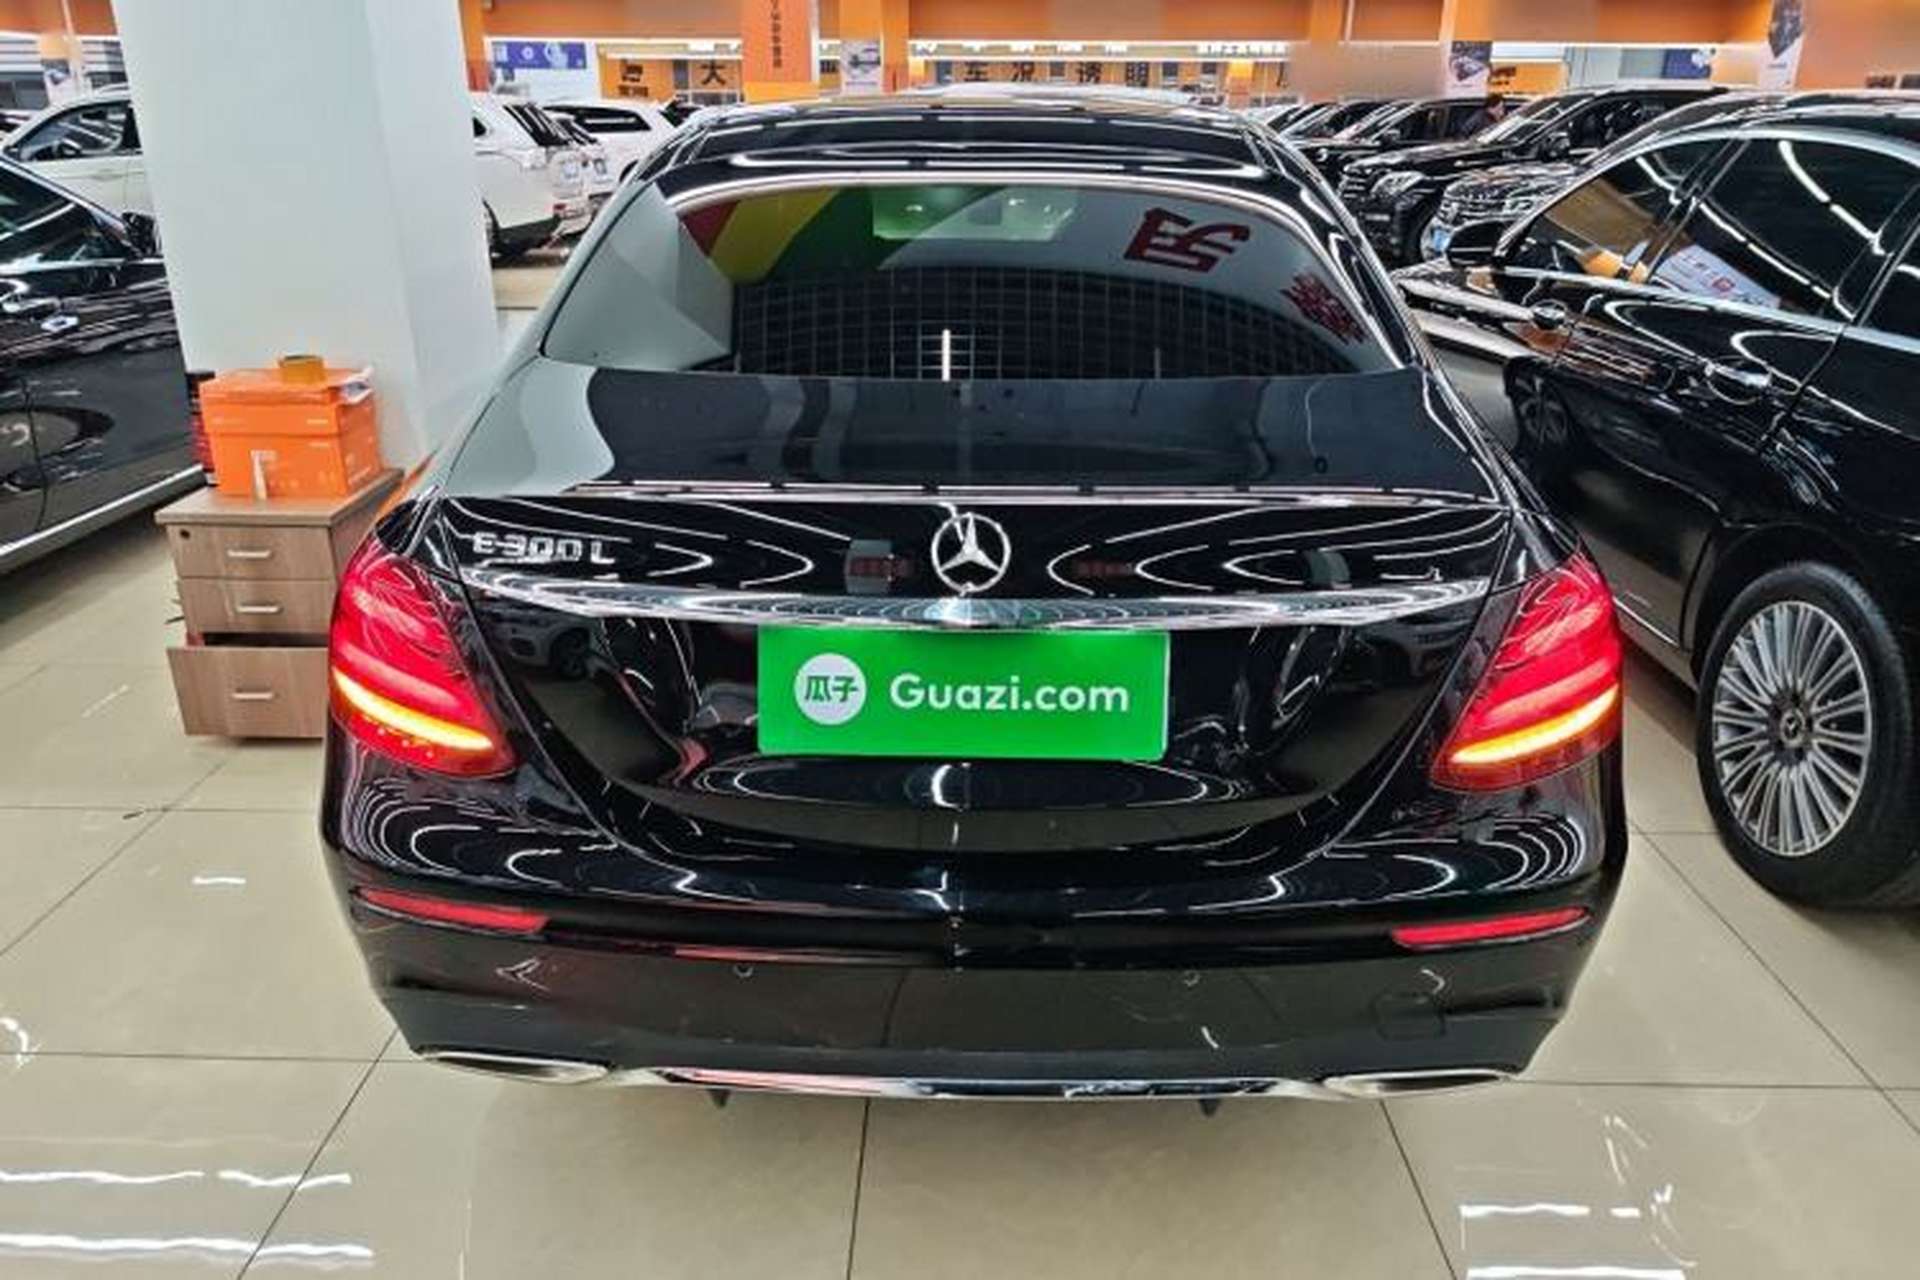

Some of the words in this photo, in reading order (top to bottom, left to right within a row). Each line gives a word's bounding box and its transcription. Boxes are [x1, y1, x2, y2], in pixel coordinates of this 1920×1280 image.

[700, 60, 726, 85] 大
[472, 531, 583, 562] E300
[590, 541, 615, 564] L
[805, 675, 859, 703] 瓜子
[889, 672, 1130, 712] Guazi.com
